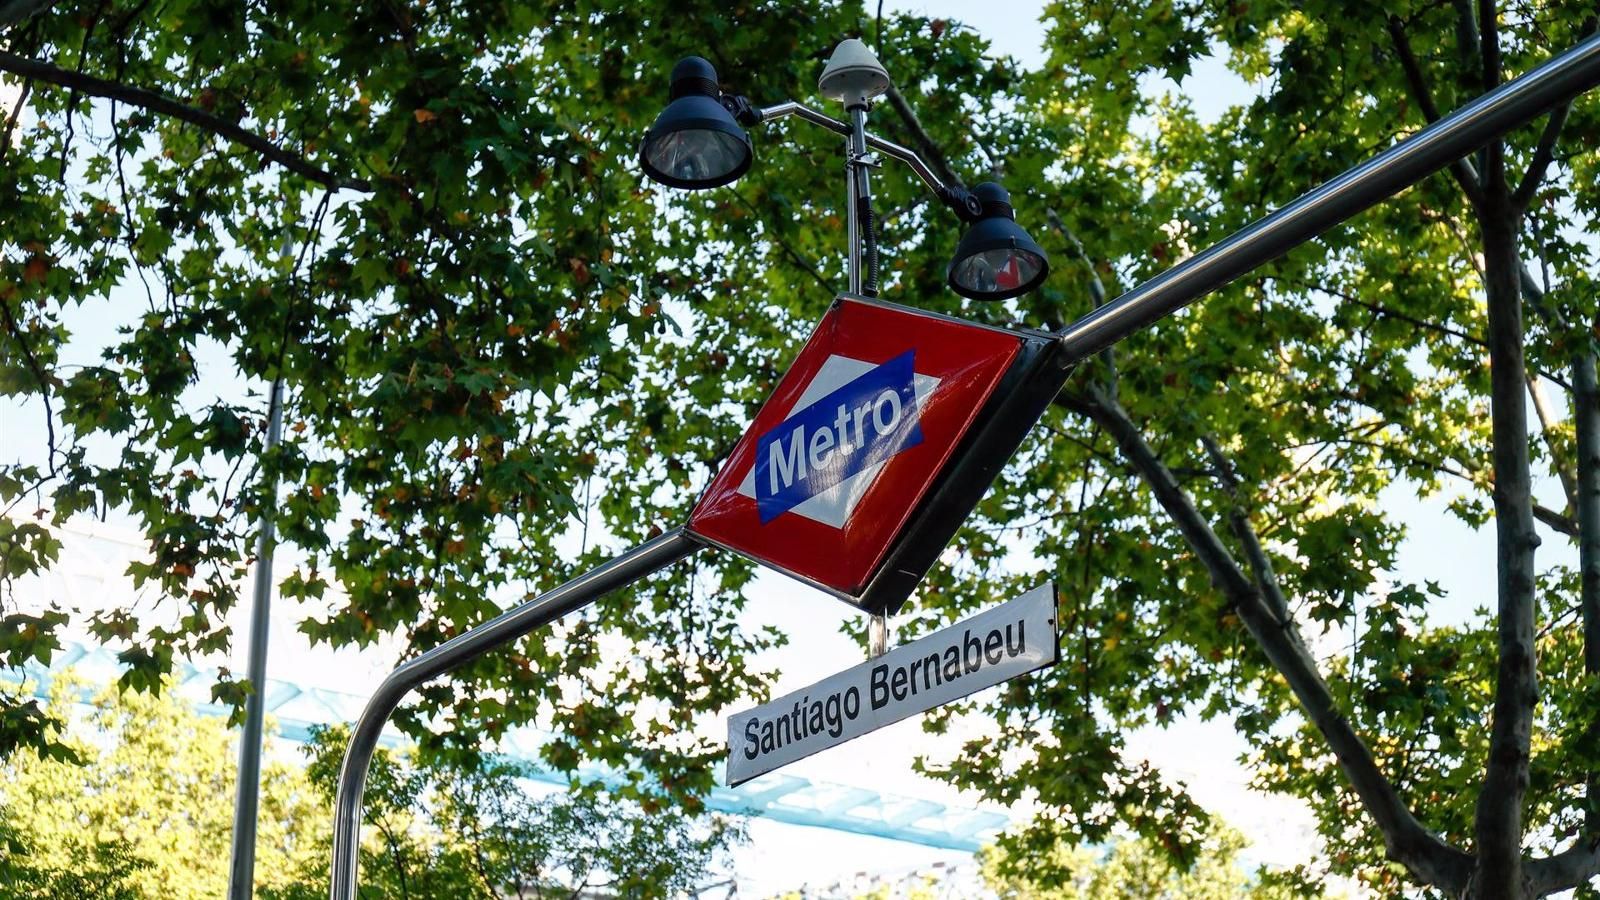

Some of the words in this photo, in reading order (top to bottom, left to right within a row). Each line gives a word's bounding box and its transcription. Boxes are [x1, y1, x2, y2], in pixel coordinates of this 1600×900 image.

[769, 389, 902, 496] Metro
[744, 686, 860, 760] Santiago
[870, 619, 1026, 711] Bernabeu
